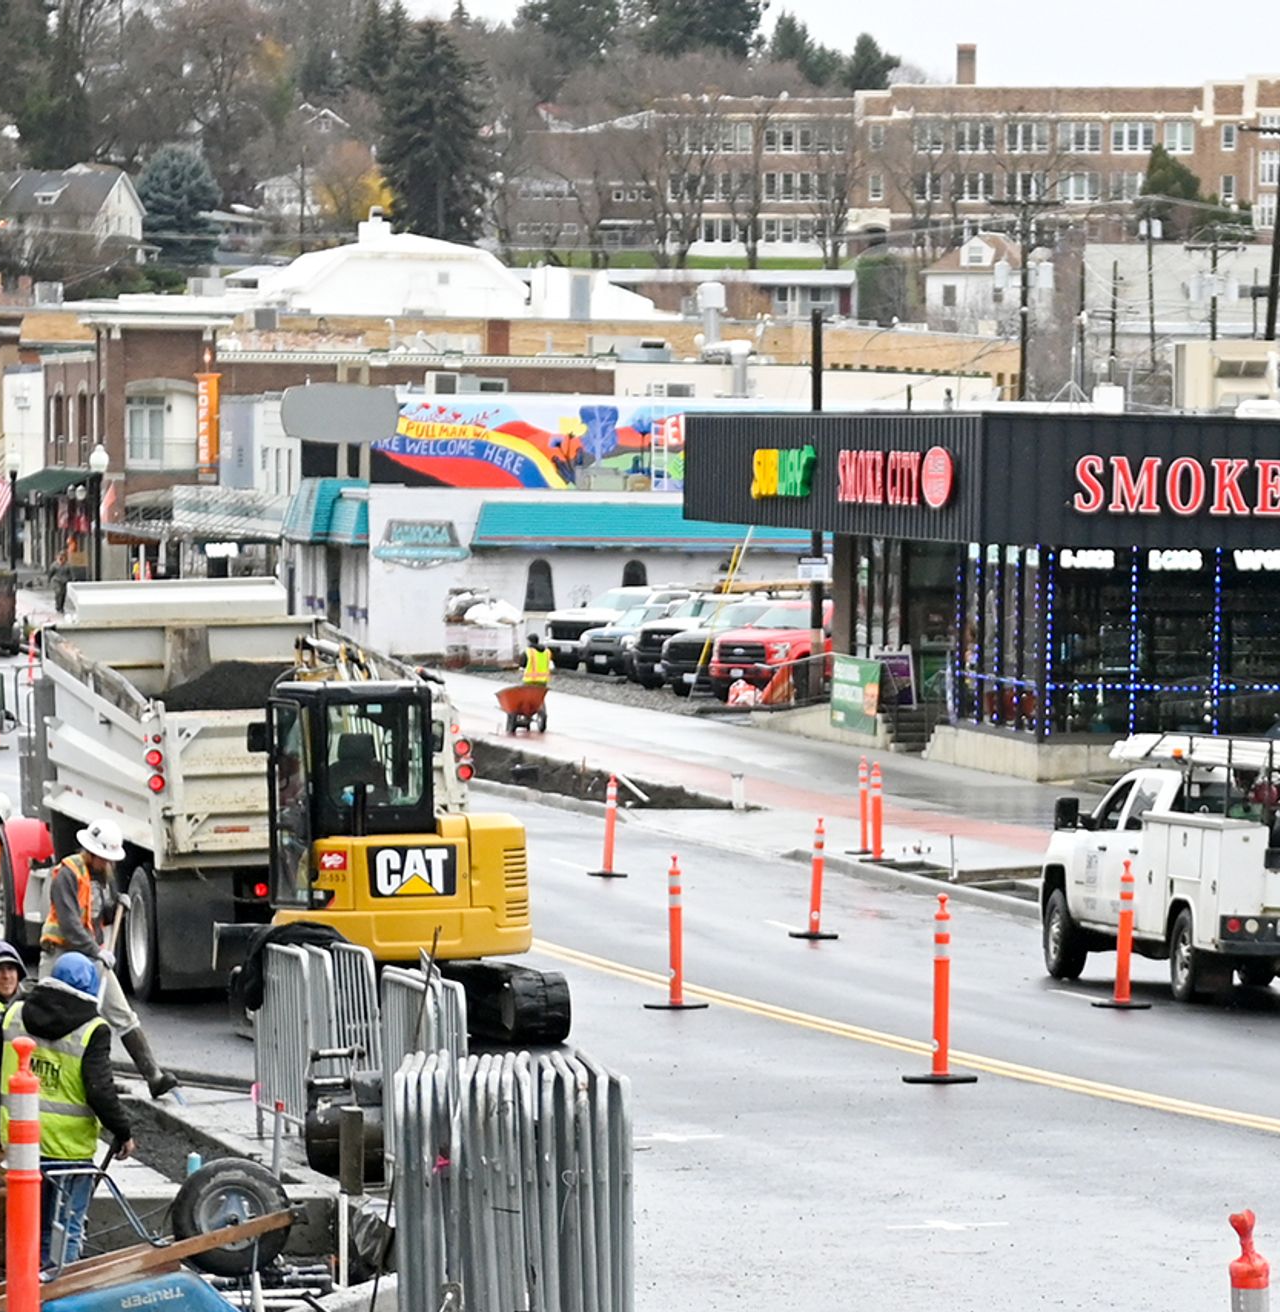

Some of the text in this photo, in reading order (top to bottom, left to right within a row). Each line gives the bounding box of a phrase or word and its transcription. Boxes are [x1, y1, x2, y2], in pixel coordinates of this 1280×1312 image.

[198, 381, 208, 463] COFFEE
[405, 438, 475, 456] WELCOME
[483, 444, 525, 476] HERE
[838, 449, 882, 504] SMOKE
[887, 450, 920, 505] CITY
[376, 848, 449, 896] CAT
[121, 1287, 185, 1309] TRUPER
